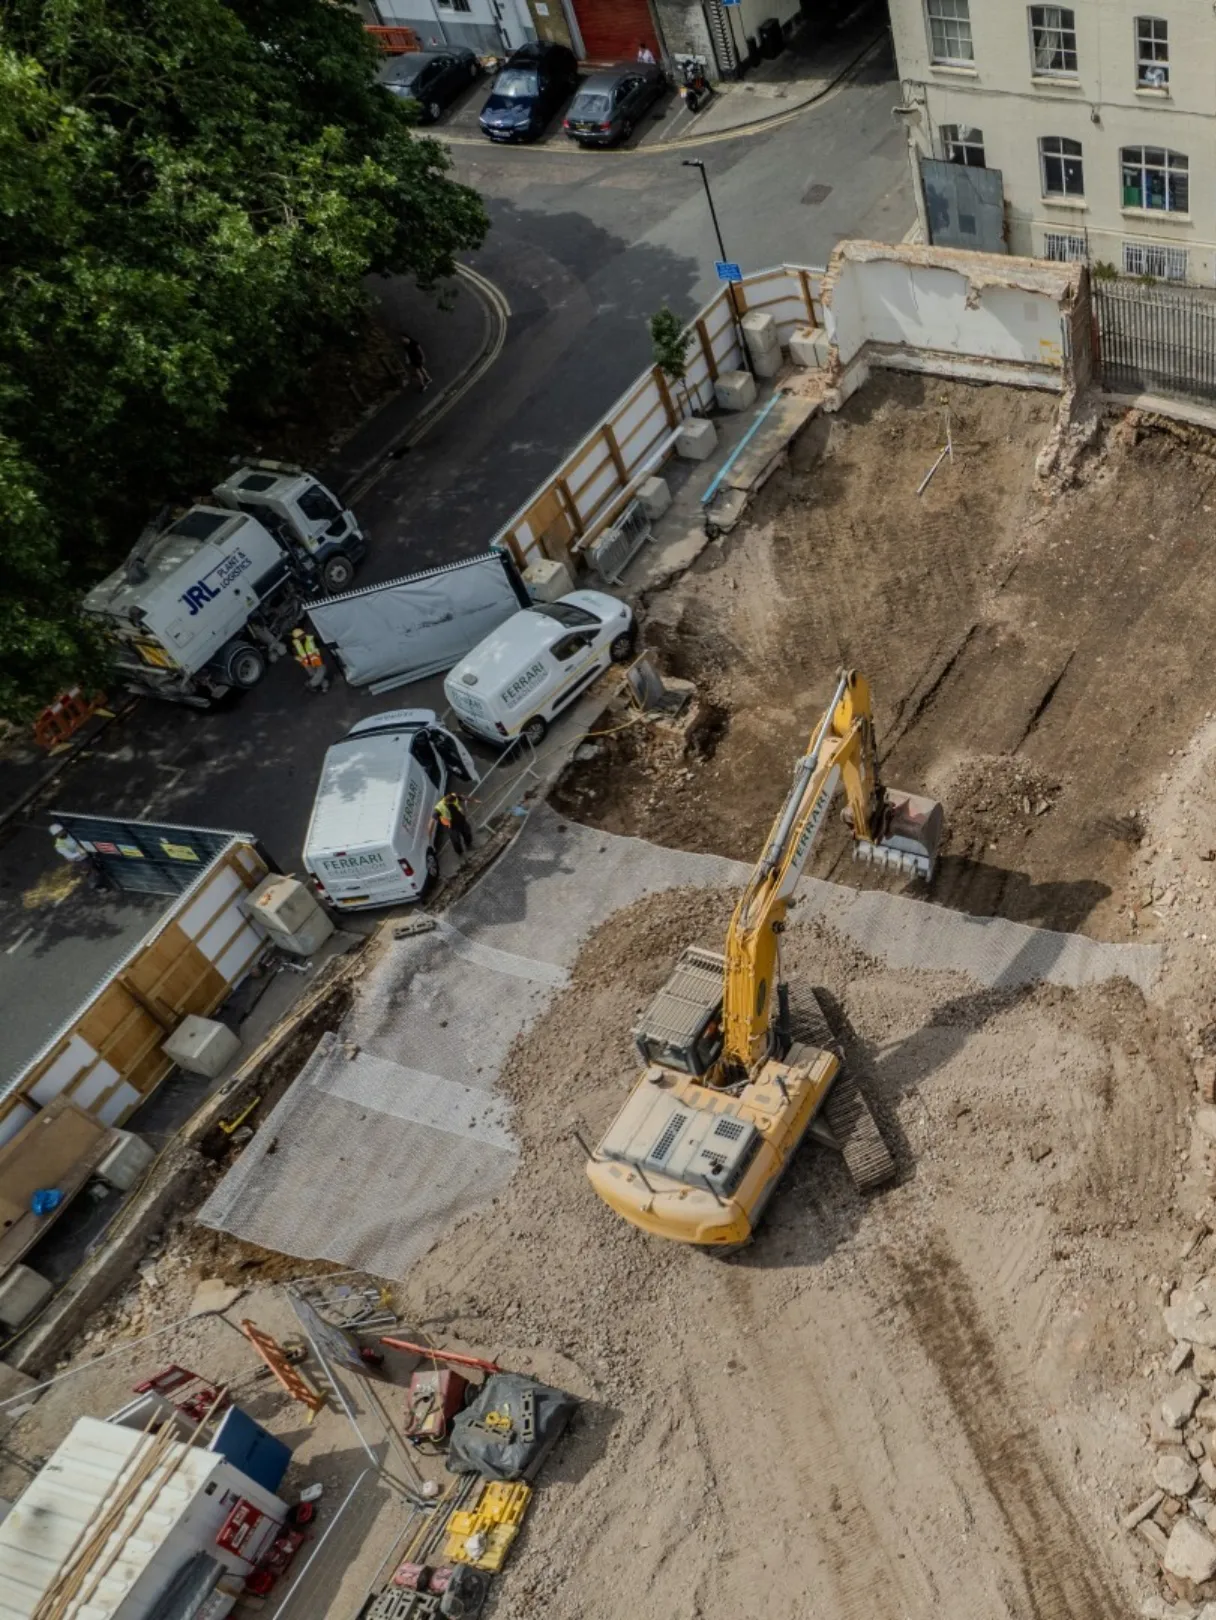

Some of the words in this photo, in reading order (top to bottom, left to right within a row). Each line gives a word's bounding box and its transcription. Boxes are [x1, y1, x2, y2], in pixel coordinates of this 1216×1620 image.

[217, 555, 239, 578] PLANT
[220, 557, 252, 589] LOGISTICS
[182, 580, 221, 616] JRL
[501, 661, 544, 703] FERRARI
[402, 779, 418, 833] FERRARI
[791, 789, 828, 869] FERRARI
[322, 853, 384, 870] FERRARI
